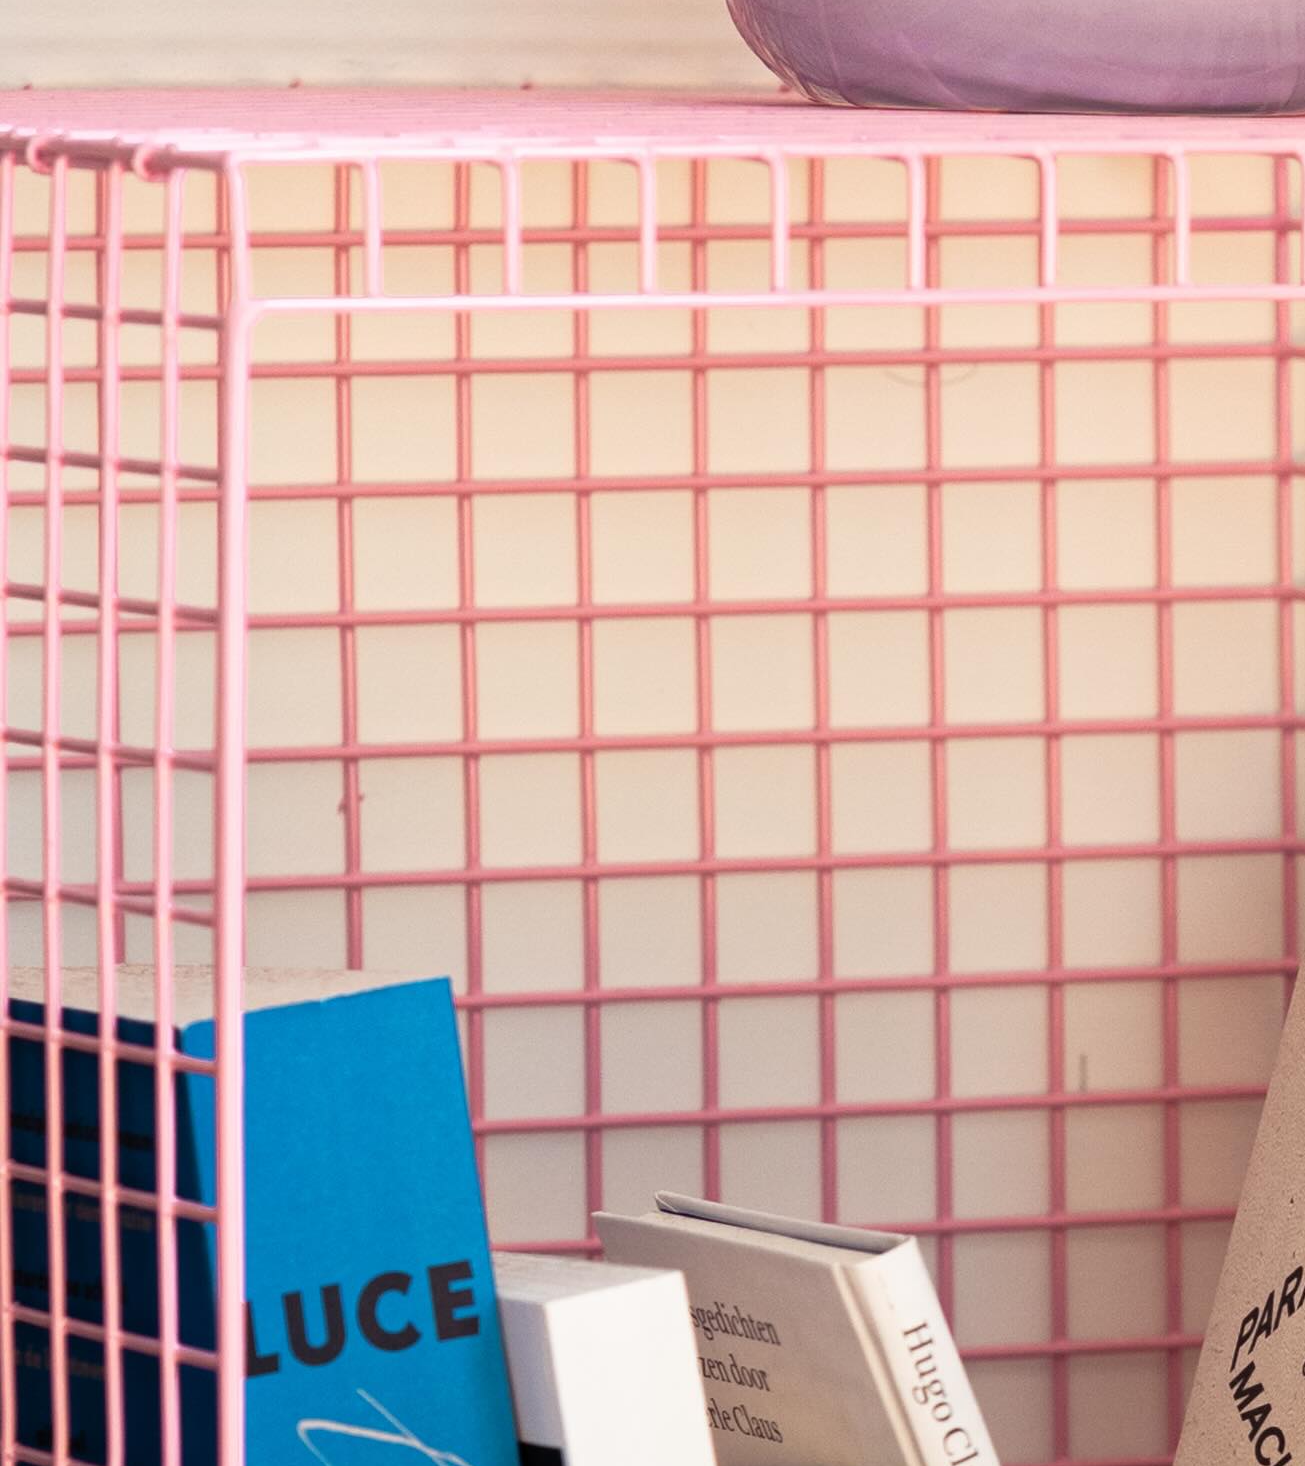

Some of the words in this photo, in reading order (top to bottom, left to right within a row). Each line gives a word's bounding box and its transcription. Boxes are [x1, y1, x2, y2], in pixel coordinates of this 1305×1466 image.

[243, 1259, 481, 1378] LUCE
[690, 1302, 781, 1346] sgedichten
[698, 1356, 733, 1384] zen
[730, 1353, 770, 1392] door
[903, 1322, 953, 1422] Hugo
[732, 1404, 783, 1443] Claus
